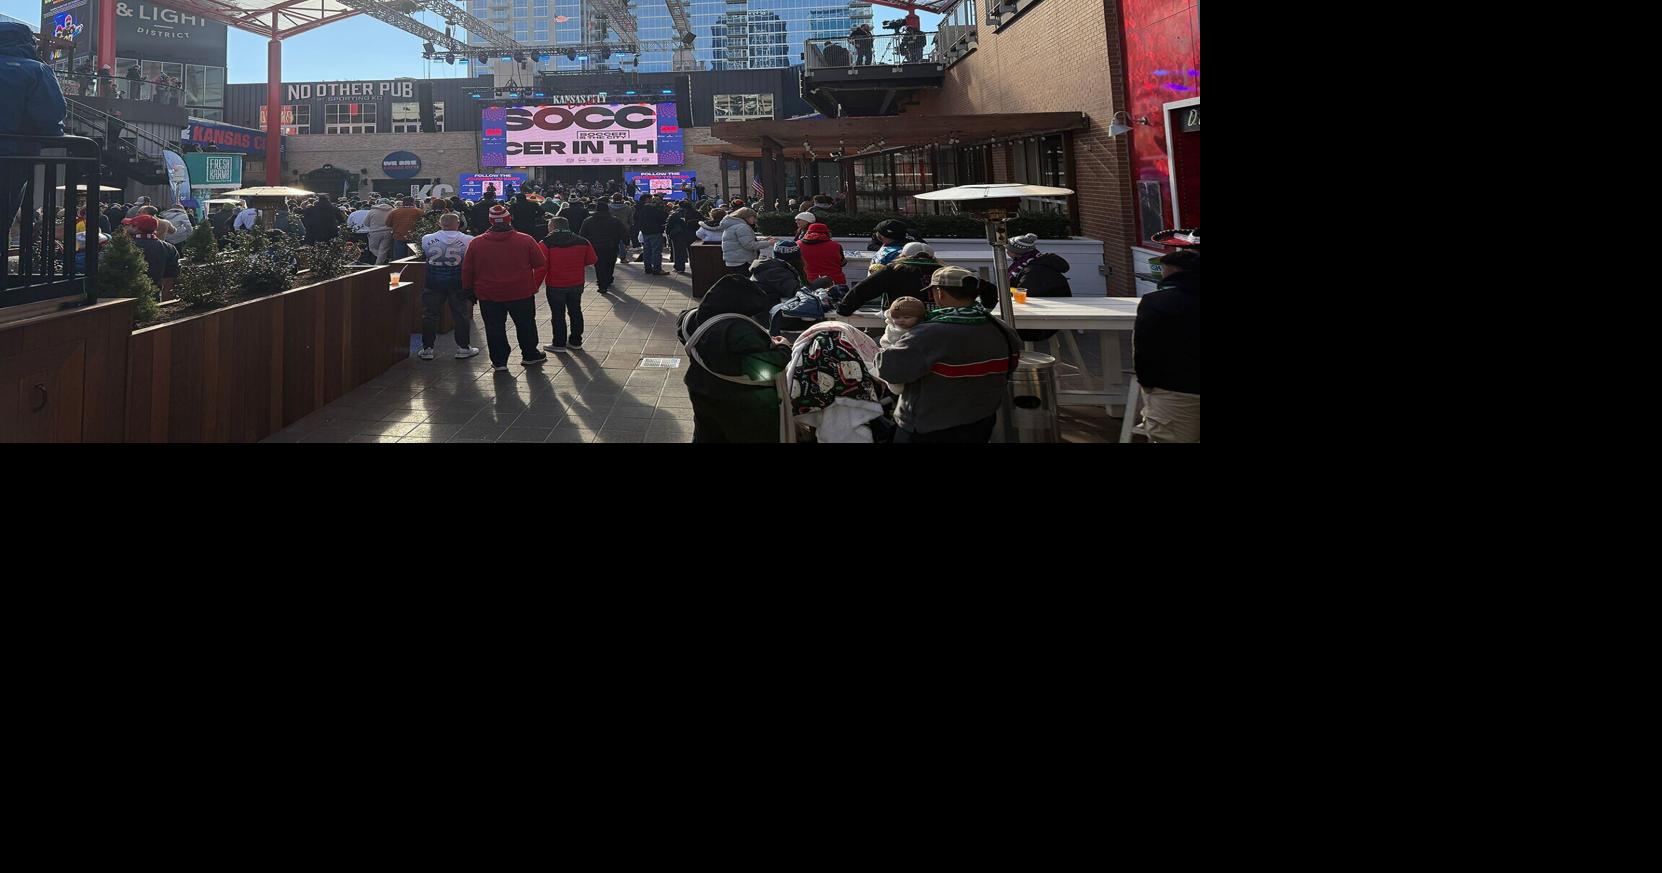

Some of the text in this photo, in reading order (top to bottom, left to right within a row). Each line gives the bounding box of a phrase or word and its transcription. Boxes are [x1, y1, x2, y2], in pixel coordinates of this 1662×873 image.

[115, 2, 134, 17] &
[137, 27, 191, 39] DISTRICT
[288, 81, 413, 101] NO OTHER PUB
[553, 94, 607, 105] KANSAS CITY
[506, 106, 656, 131] SOCC
[192, 125, 251, 149] KANSAS
[572, 140, 604, 155] IN
[609, 139, 654, 154] TH
[209, 158, 230, 169] FRESH
[209, 169, 230, 180] KARMA
[410, 183, 455, 200] KC
[428, 246, 462, 267] 25
